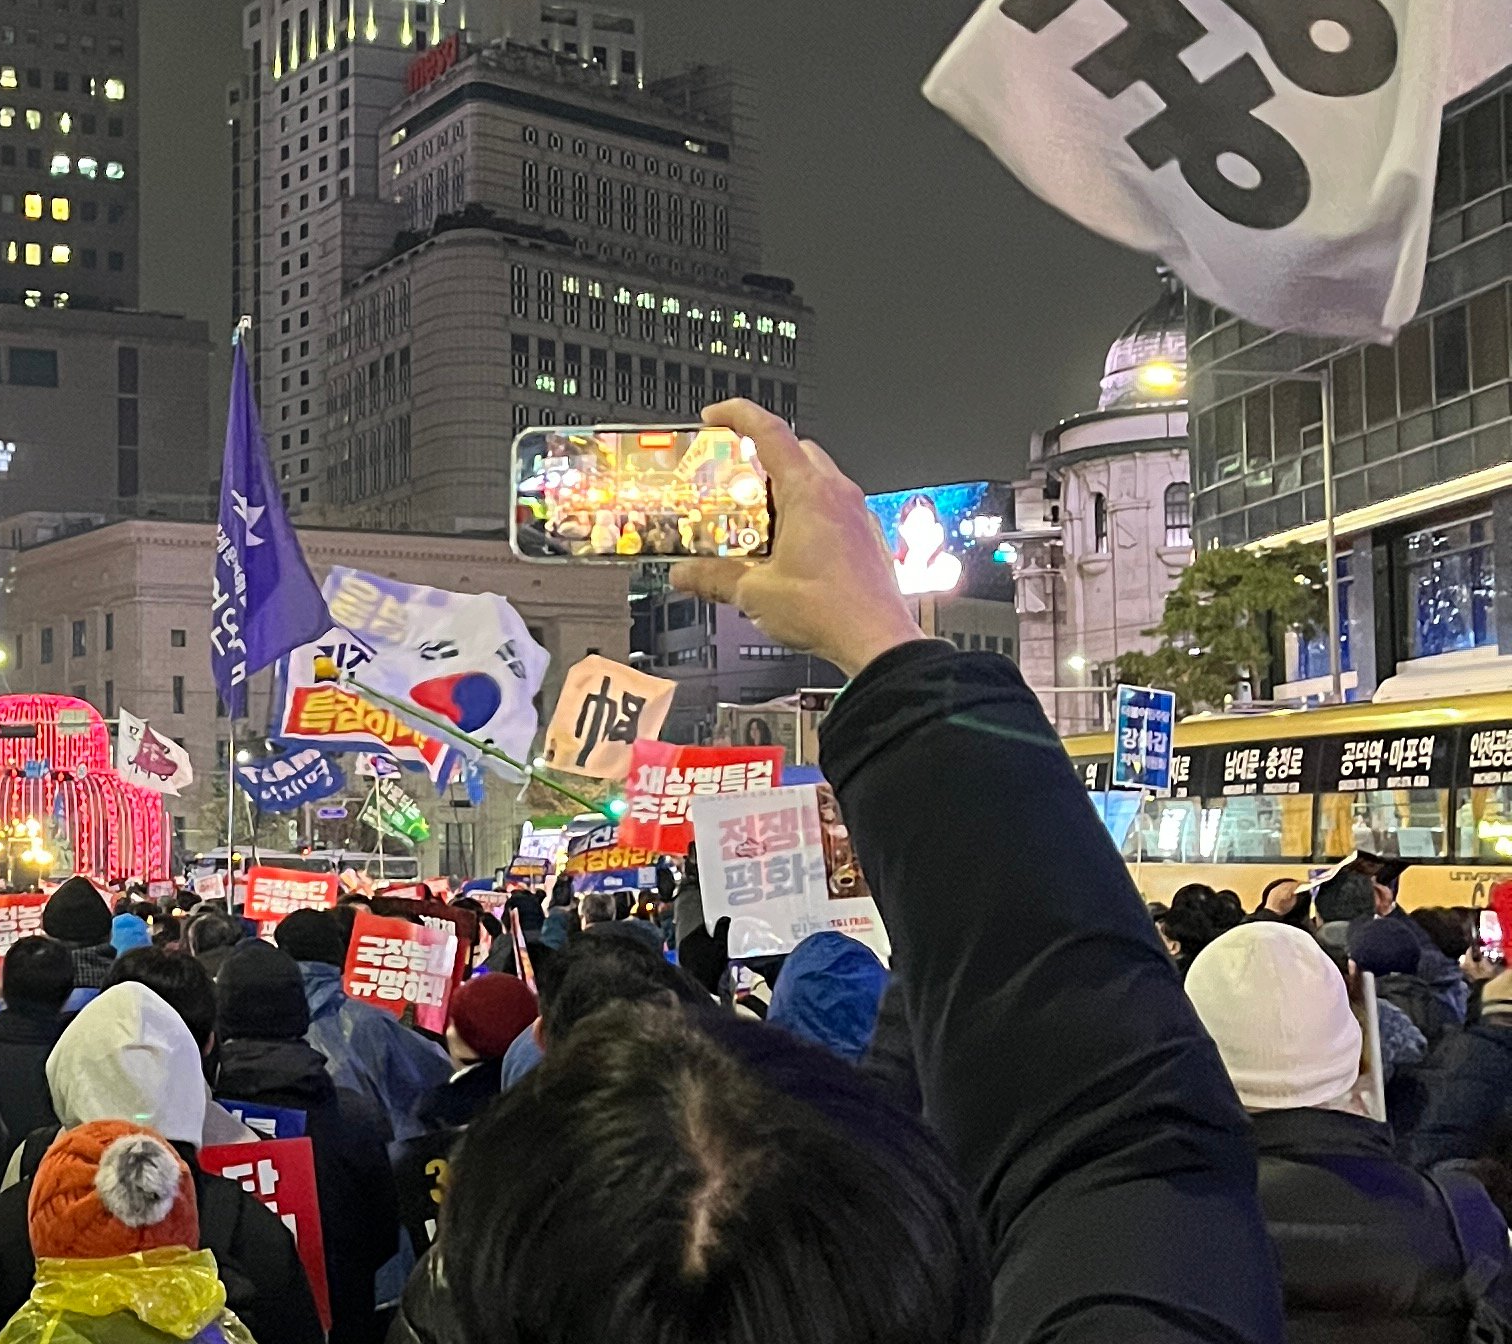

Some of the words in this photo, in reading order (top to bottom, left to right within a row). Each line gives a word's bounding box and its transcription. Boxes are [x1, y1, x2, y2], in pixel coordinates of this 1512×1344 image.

[239, 748, 321, 784] TEAM
[634, 760, 774, 797] 채상병특검
[630, 794, 694, 826] 추진
[356, 935, 457, 976] 국정농
